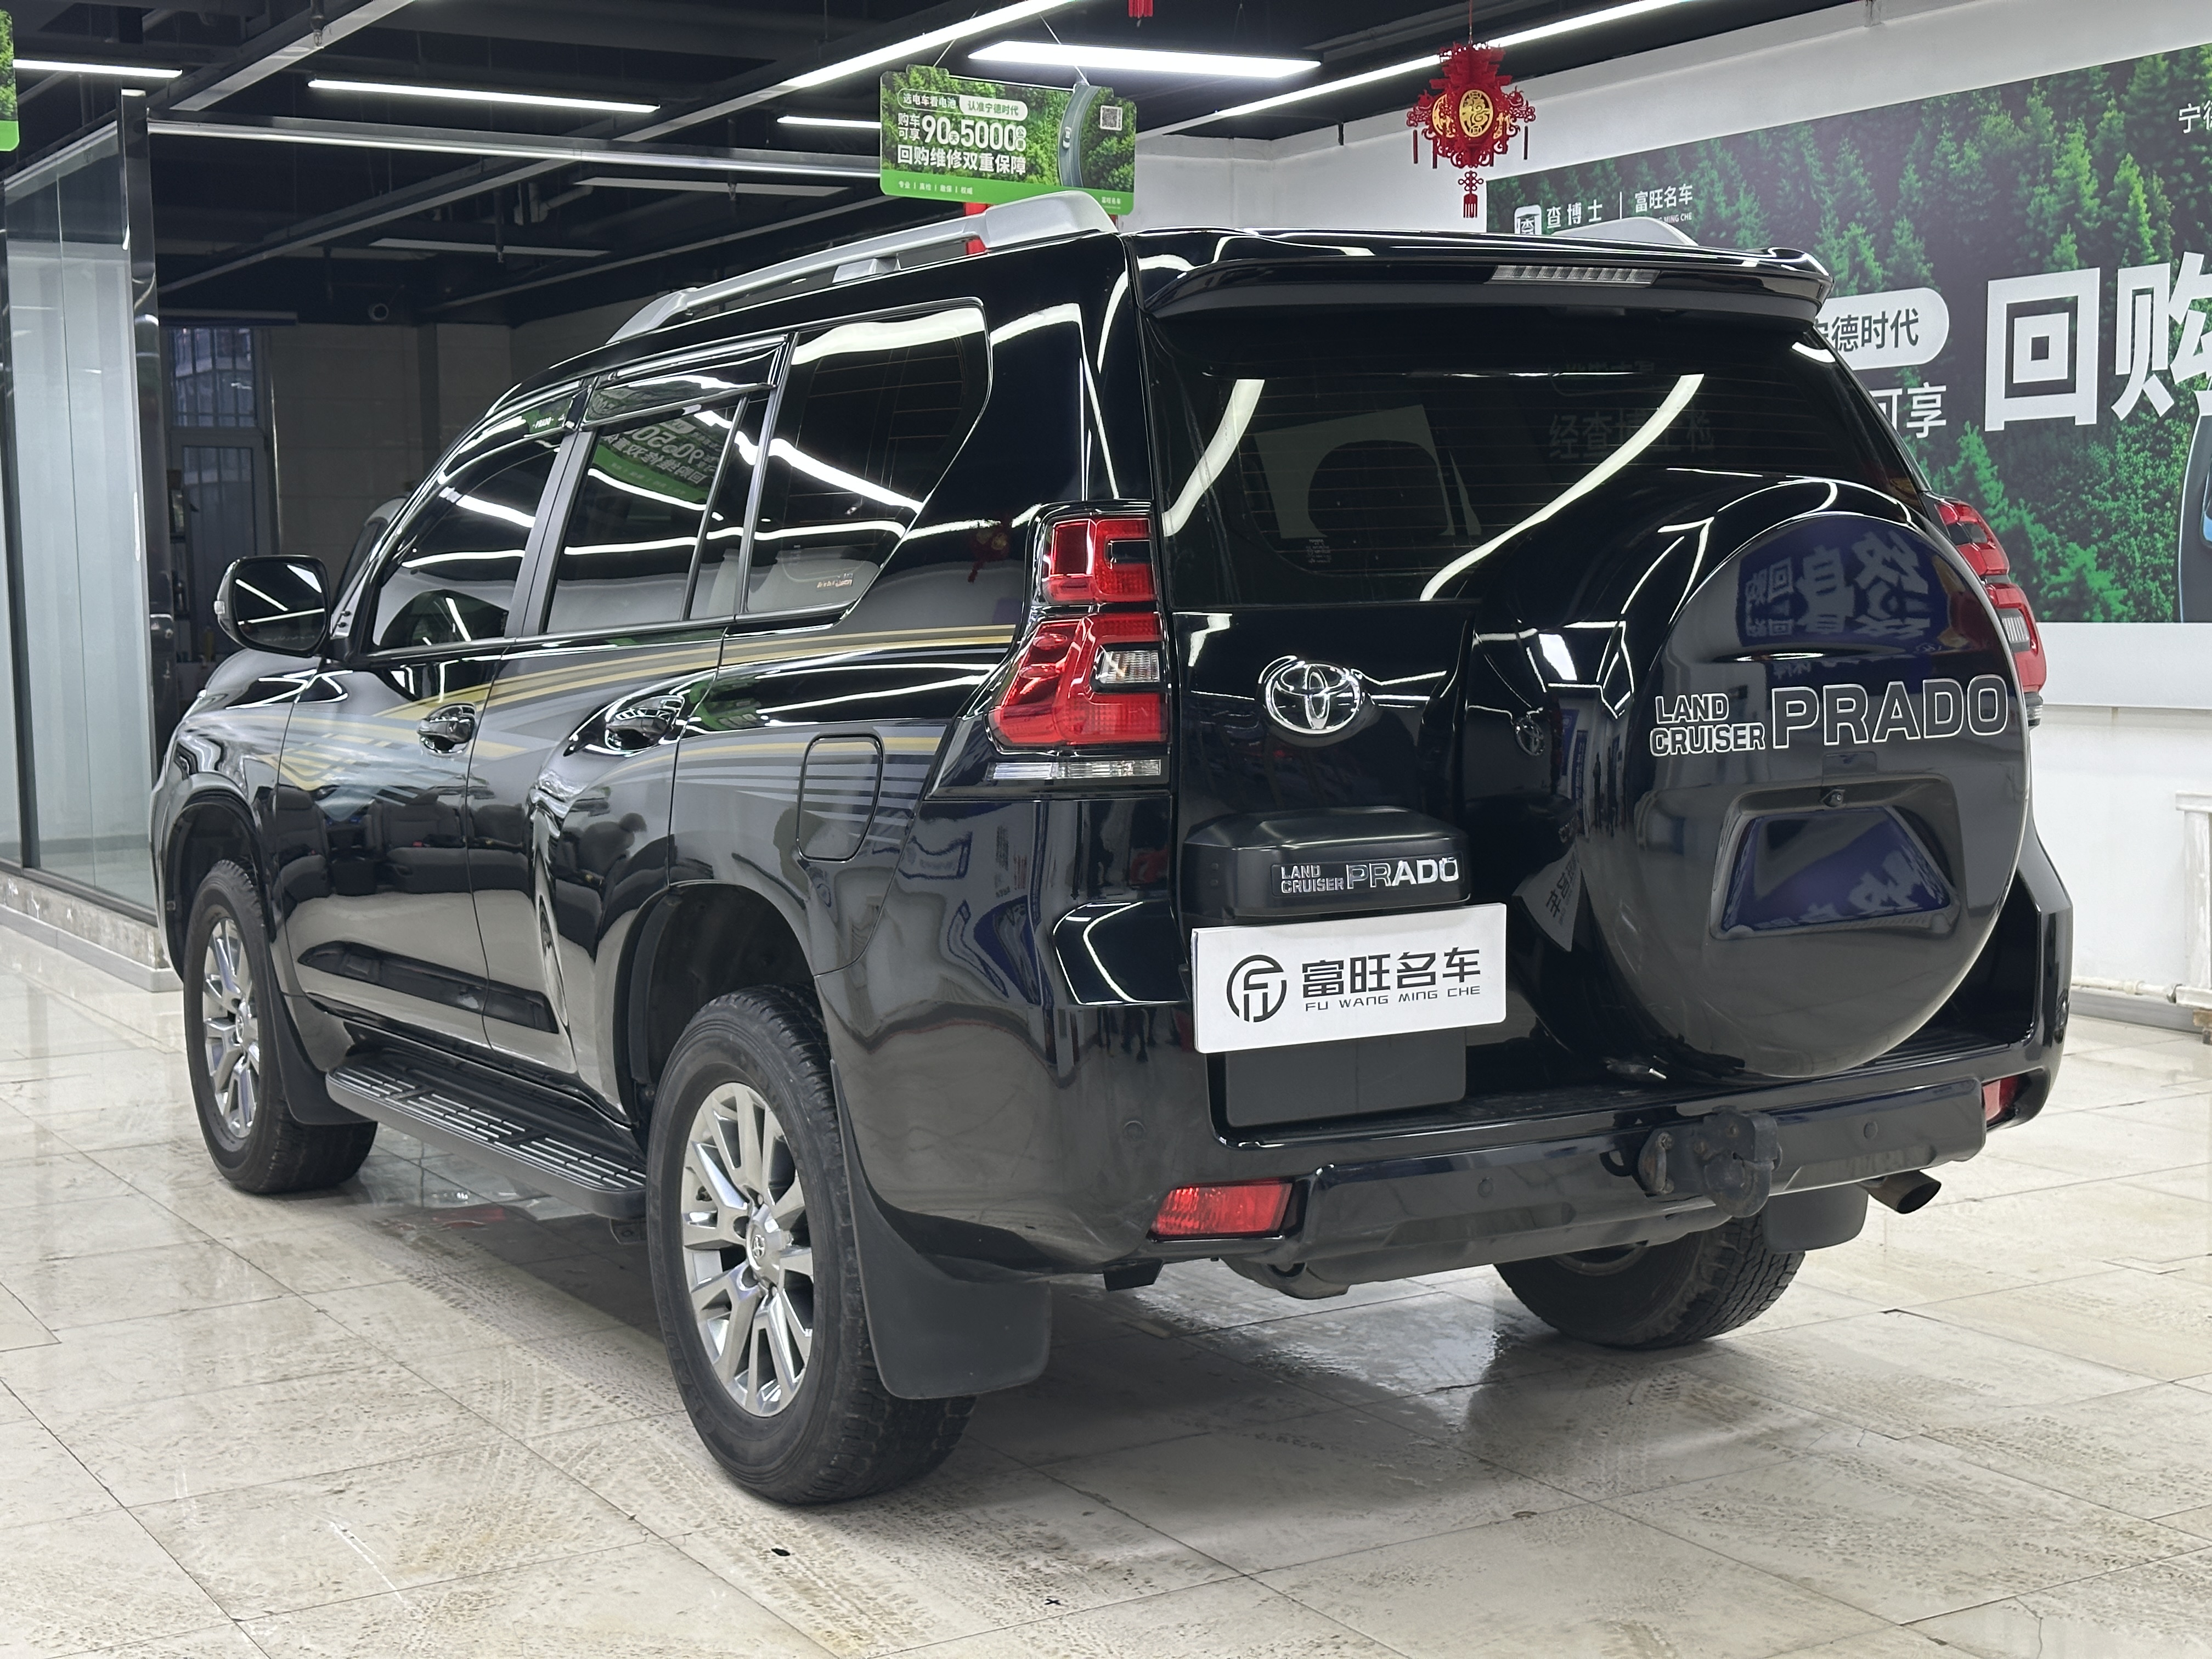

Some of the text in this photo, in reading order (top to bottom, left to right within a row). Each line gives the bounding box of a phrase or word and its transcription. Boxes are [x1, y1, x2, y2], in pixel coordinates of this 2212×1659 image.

[903, 92, 1019, 116] 选电车看电池 认准宁德时代
[898, 144, 1026, 175] 回购维修双重保障
[1635, 183, 1693, 213] 富旺名车
[1680, 212, 1692, 222] CHE
[1655, 693, 1729, 724] LAND
[1771, 674, 2008, 749] PRADO
[1650, 722, 1765, 757] CRUISER
[1281, 865, 1321, 879] LAND
[1281, 878, 1344, 894] CRUISER
[1346, 857, 1459, 890] PRADO
[1302, 947, 1480, 998] 富旺名车
[1305, 985, 1480, 1012] FU WANG MING CHE
